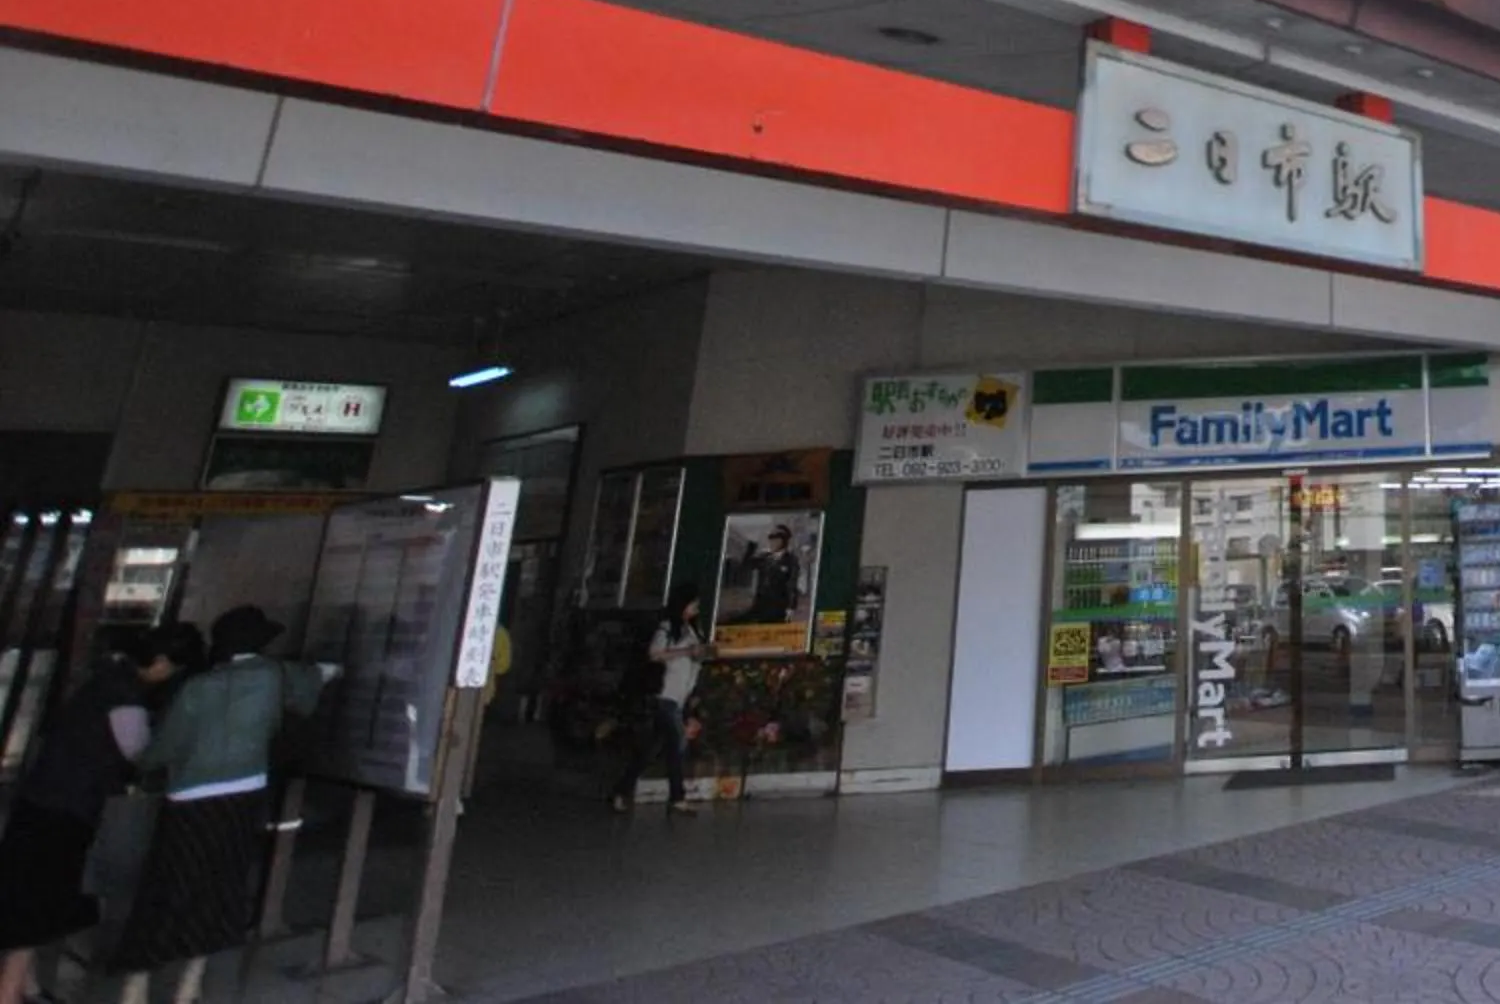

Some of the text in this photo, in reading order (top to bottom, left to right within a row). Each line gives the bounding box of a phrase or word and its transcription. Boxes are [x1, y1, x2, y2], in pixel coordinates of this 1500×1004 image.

[1124, 107, 1397, 224] 二日市駅
[1150, 399, 1392, 452] FamilyMart
